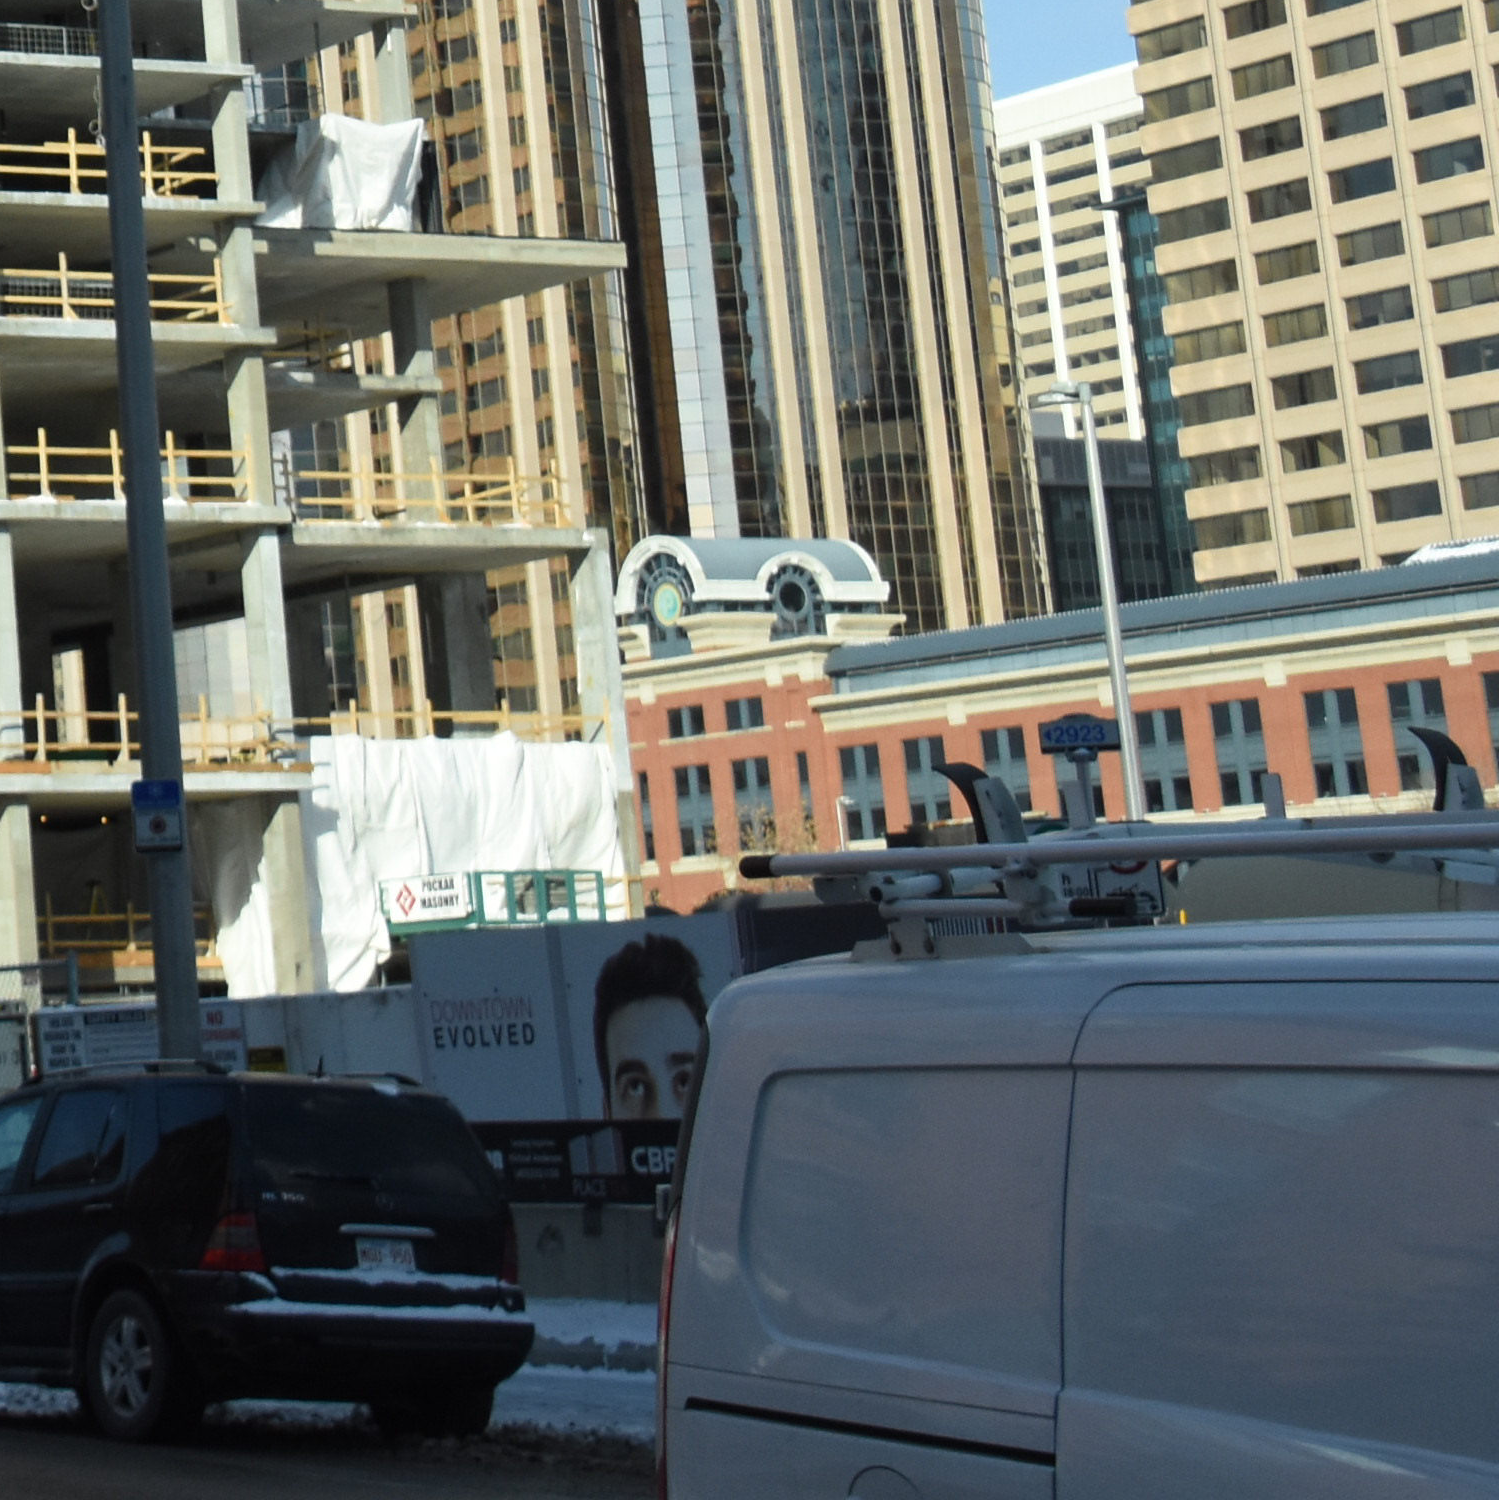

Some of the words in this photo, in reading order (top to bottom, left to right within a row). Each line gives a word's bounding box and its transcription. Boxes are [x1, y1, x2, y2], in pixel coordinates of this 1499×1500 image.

[1053, 724, 1106, 744] 2923
[420, 894, 460, 909] MASONRY
[430, 996, 533, 1023] DOWNTOWN
[433, 1022, 536, 1049] EVOLVED
